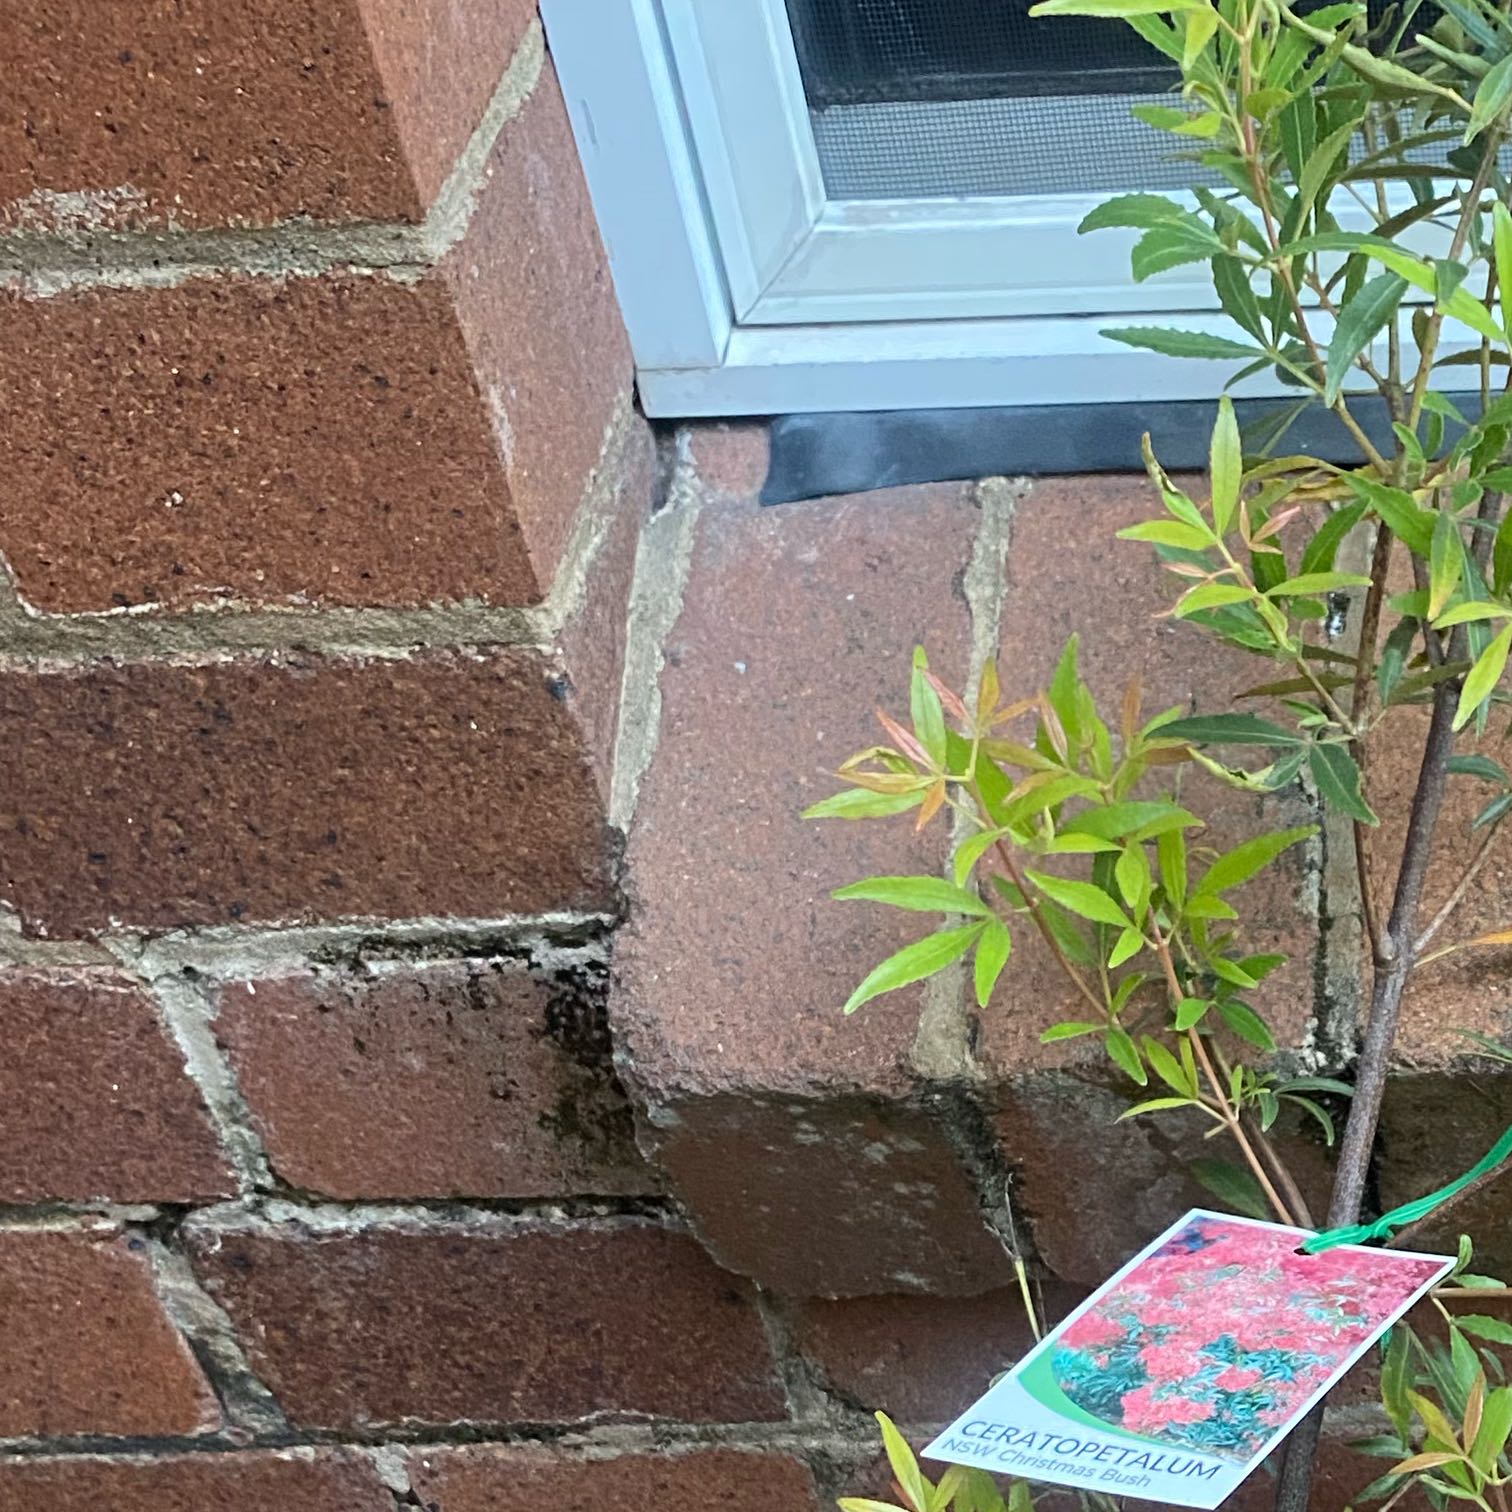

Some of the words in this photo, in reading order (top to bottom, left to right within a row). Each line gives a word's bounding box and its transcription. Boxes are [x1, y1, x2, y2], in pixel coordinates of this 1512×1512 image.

[941, 1438, 997, 1457] NSW
[1000, 1449, 1095, 1478] Christmas
[1099, 1467, 1152, 1488] Bush
[961, 1420, 1222, 1481] CERATOPETALUM
